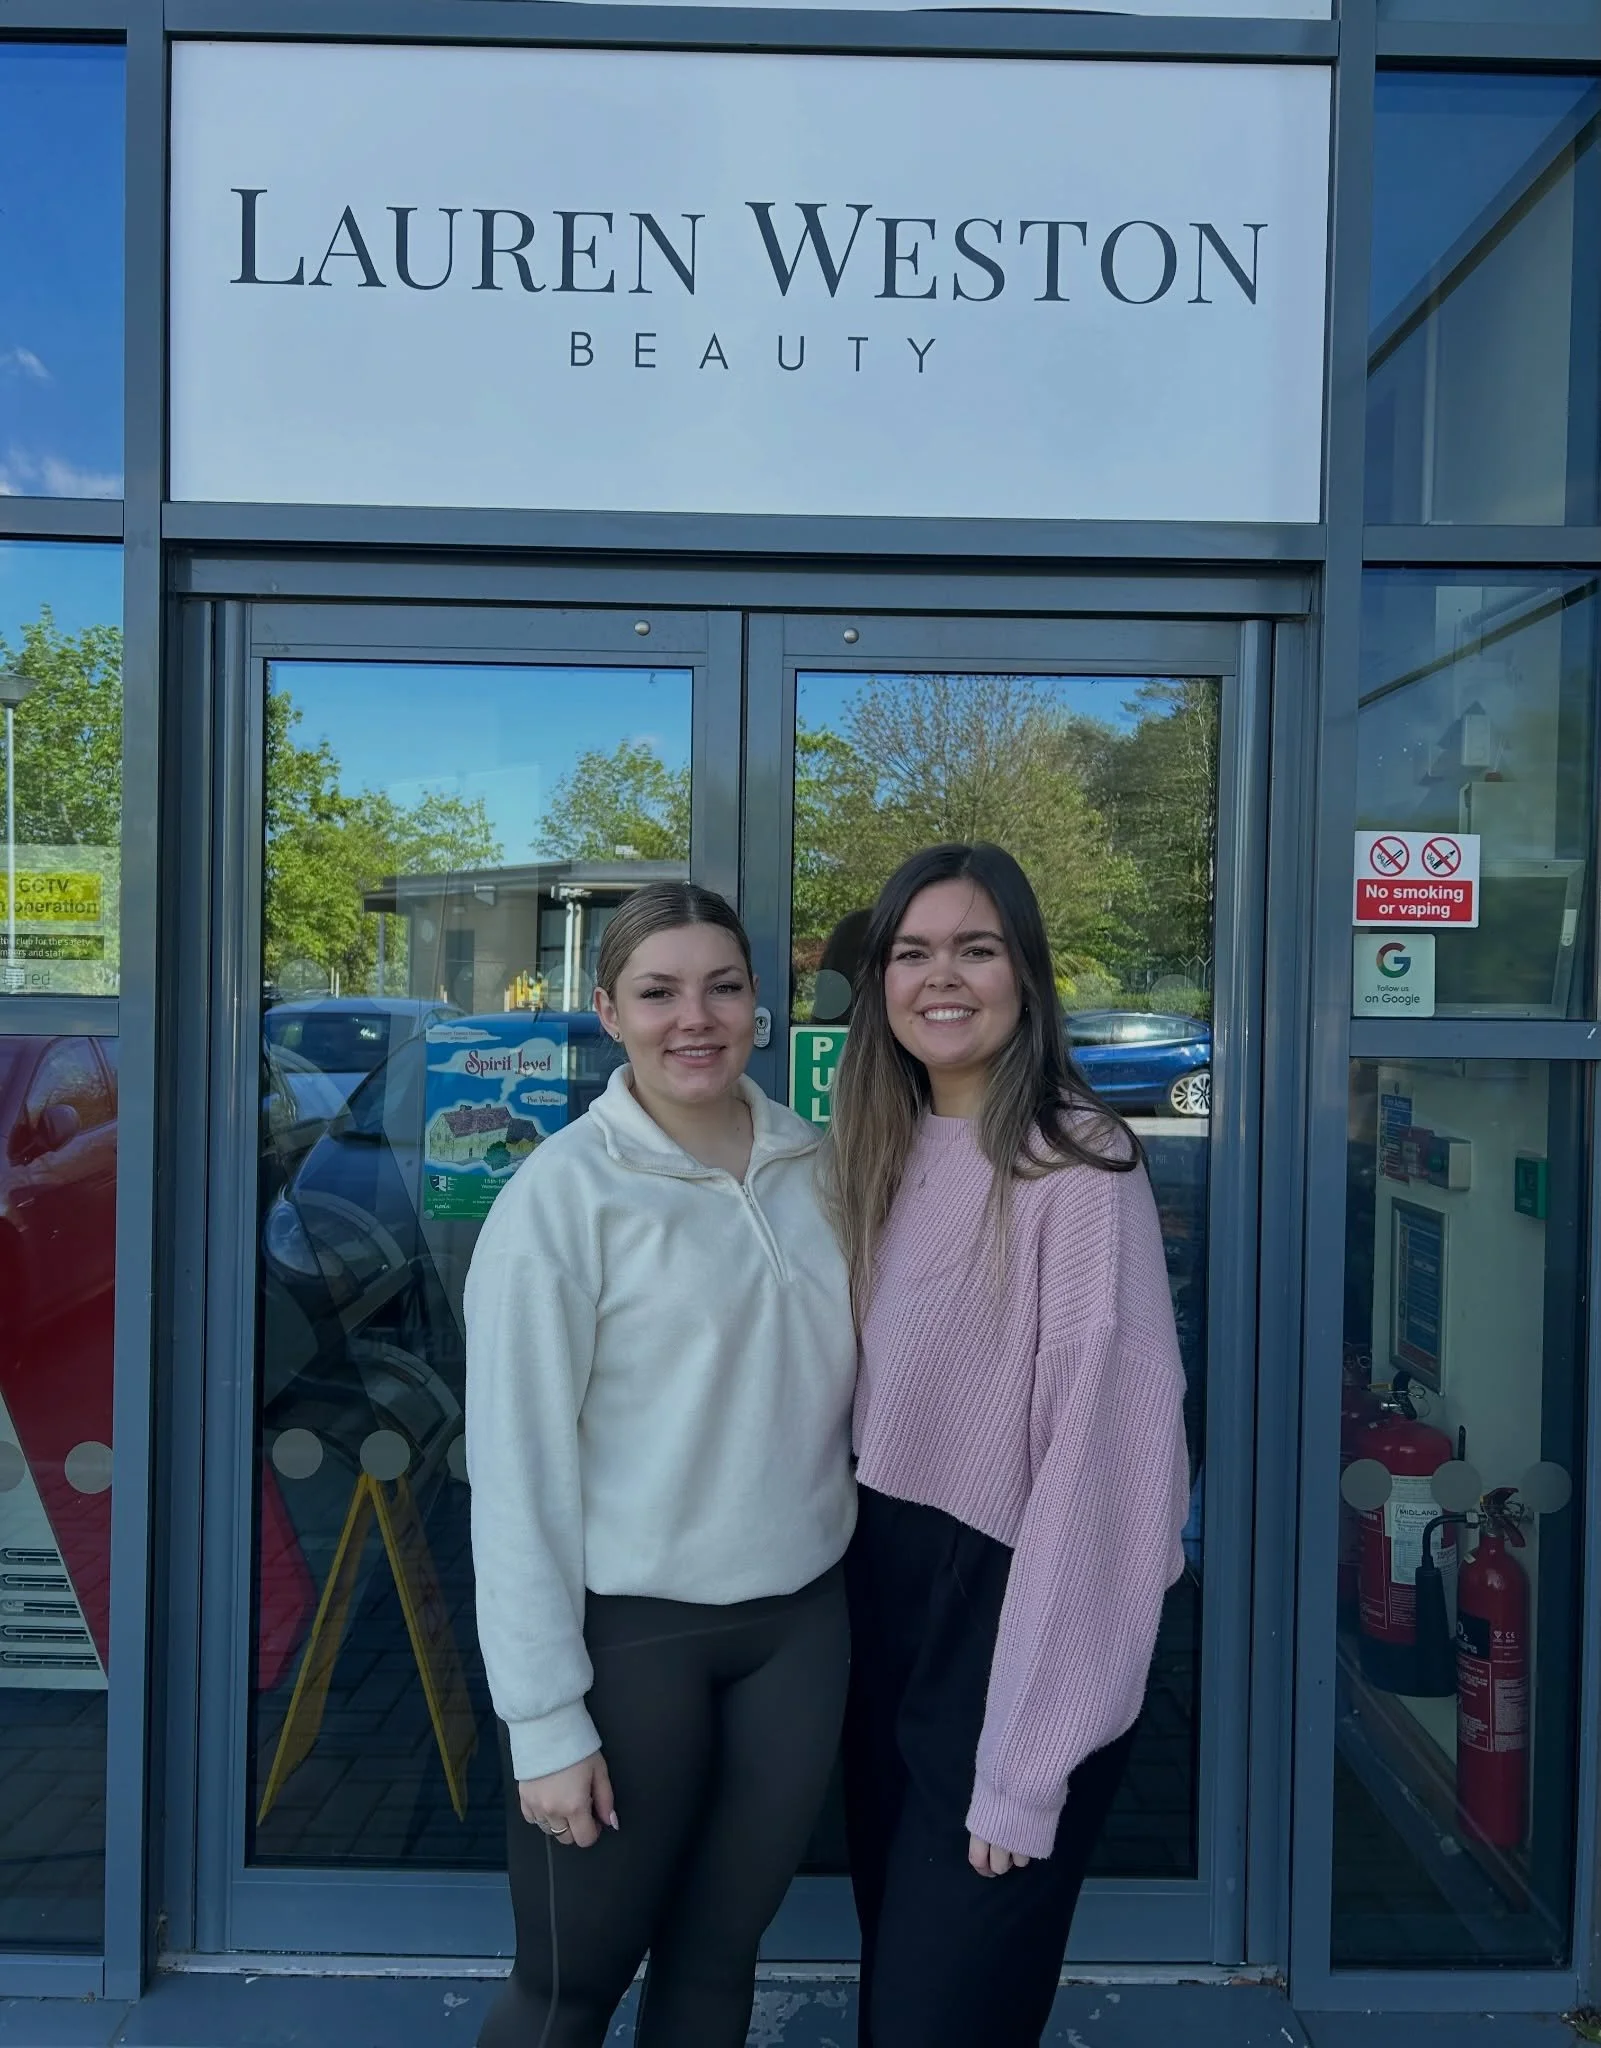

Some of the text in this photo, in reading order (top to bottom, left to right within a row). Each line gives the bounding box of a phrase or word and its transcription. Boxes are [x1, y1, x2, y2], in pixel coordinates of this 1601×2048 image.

[229, 187, 1268, 308] LAUREN WESTON
[569, 330, 936, 374] BEAUTY
[18, 878, 70, 893] CCTV
[1365, 885, 1464, 902] No smoking
[1379, 903, 1450, 918] or vaping
[16, 937, 33, 945] club
[35, 937, 46, 945] for
[48, 937, 64, 945] the
[65, 937, 90, 947] safety
[28, 949, 43, 957] and
[45, 949, 65, 957] staff
[1365, 993, 1420, 1006] on Google
[465, 1050, 512, 1077] Spirit
[811, 1036, 835, 1122] PUL
